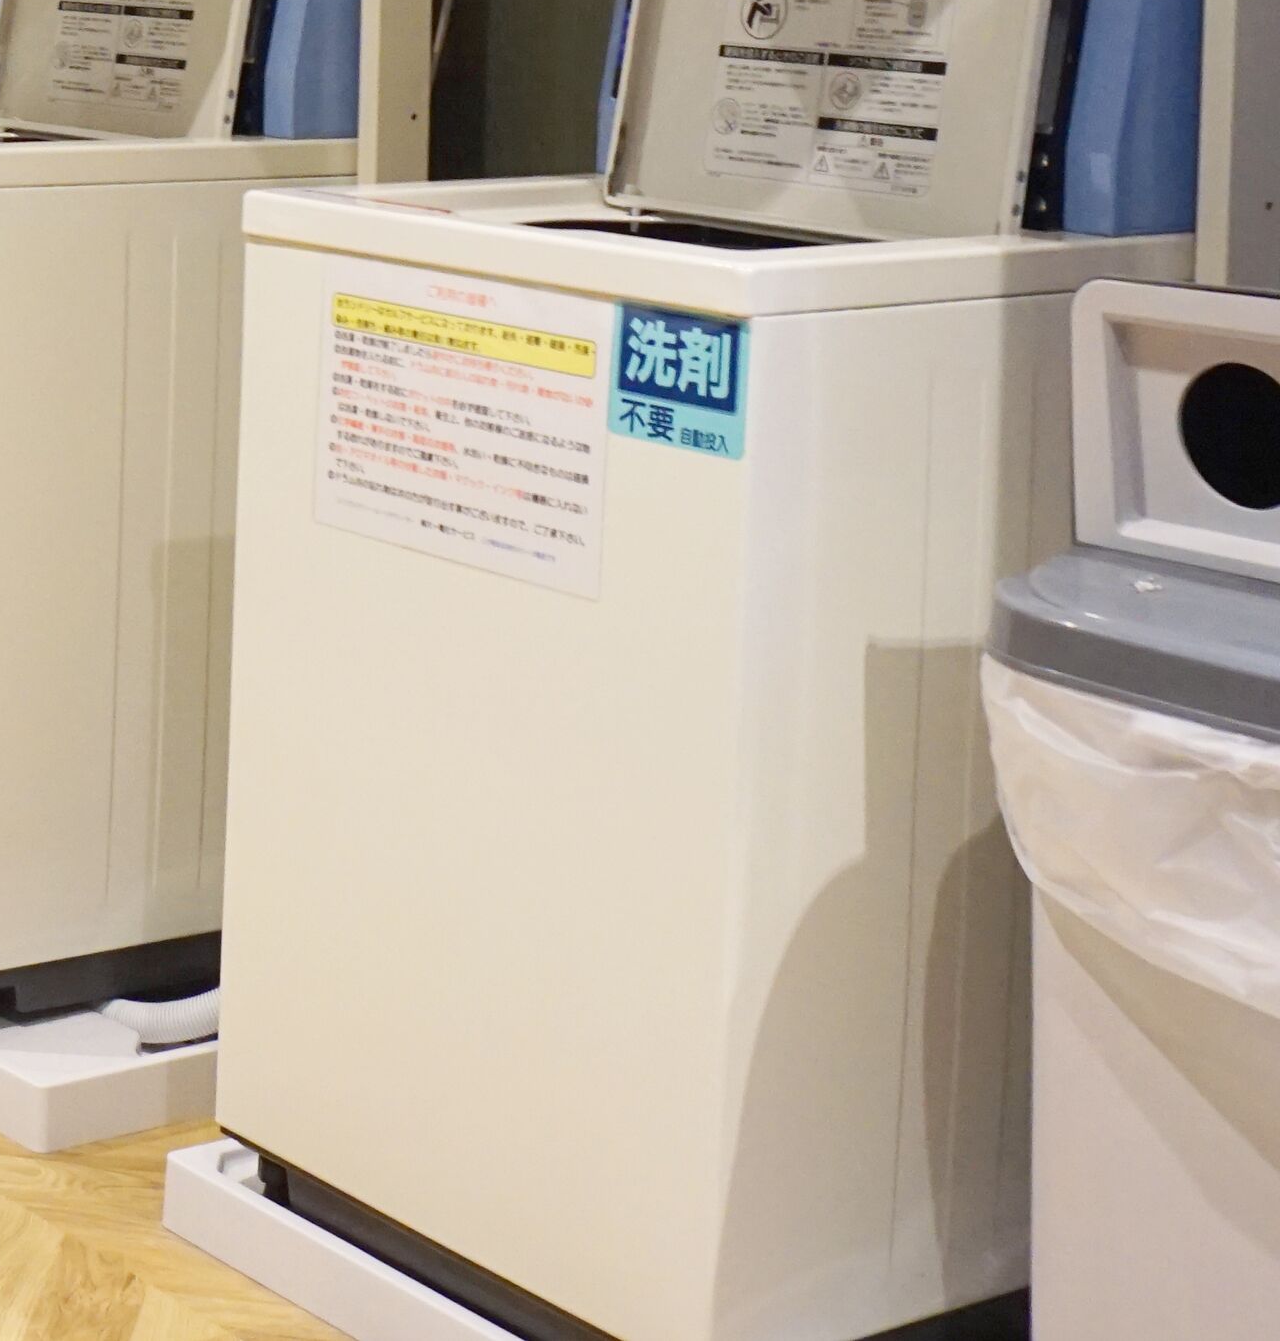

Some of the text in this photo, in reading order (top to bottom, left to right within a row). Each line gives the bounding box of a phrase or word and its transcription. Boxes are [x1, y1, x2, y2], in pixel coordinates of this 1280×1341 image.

[625, 317, 732, 400] 洗剤
[619, 398, 730, 454] 不要 自動投入
